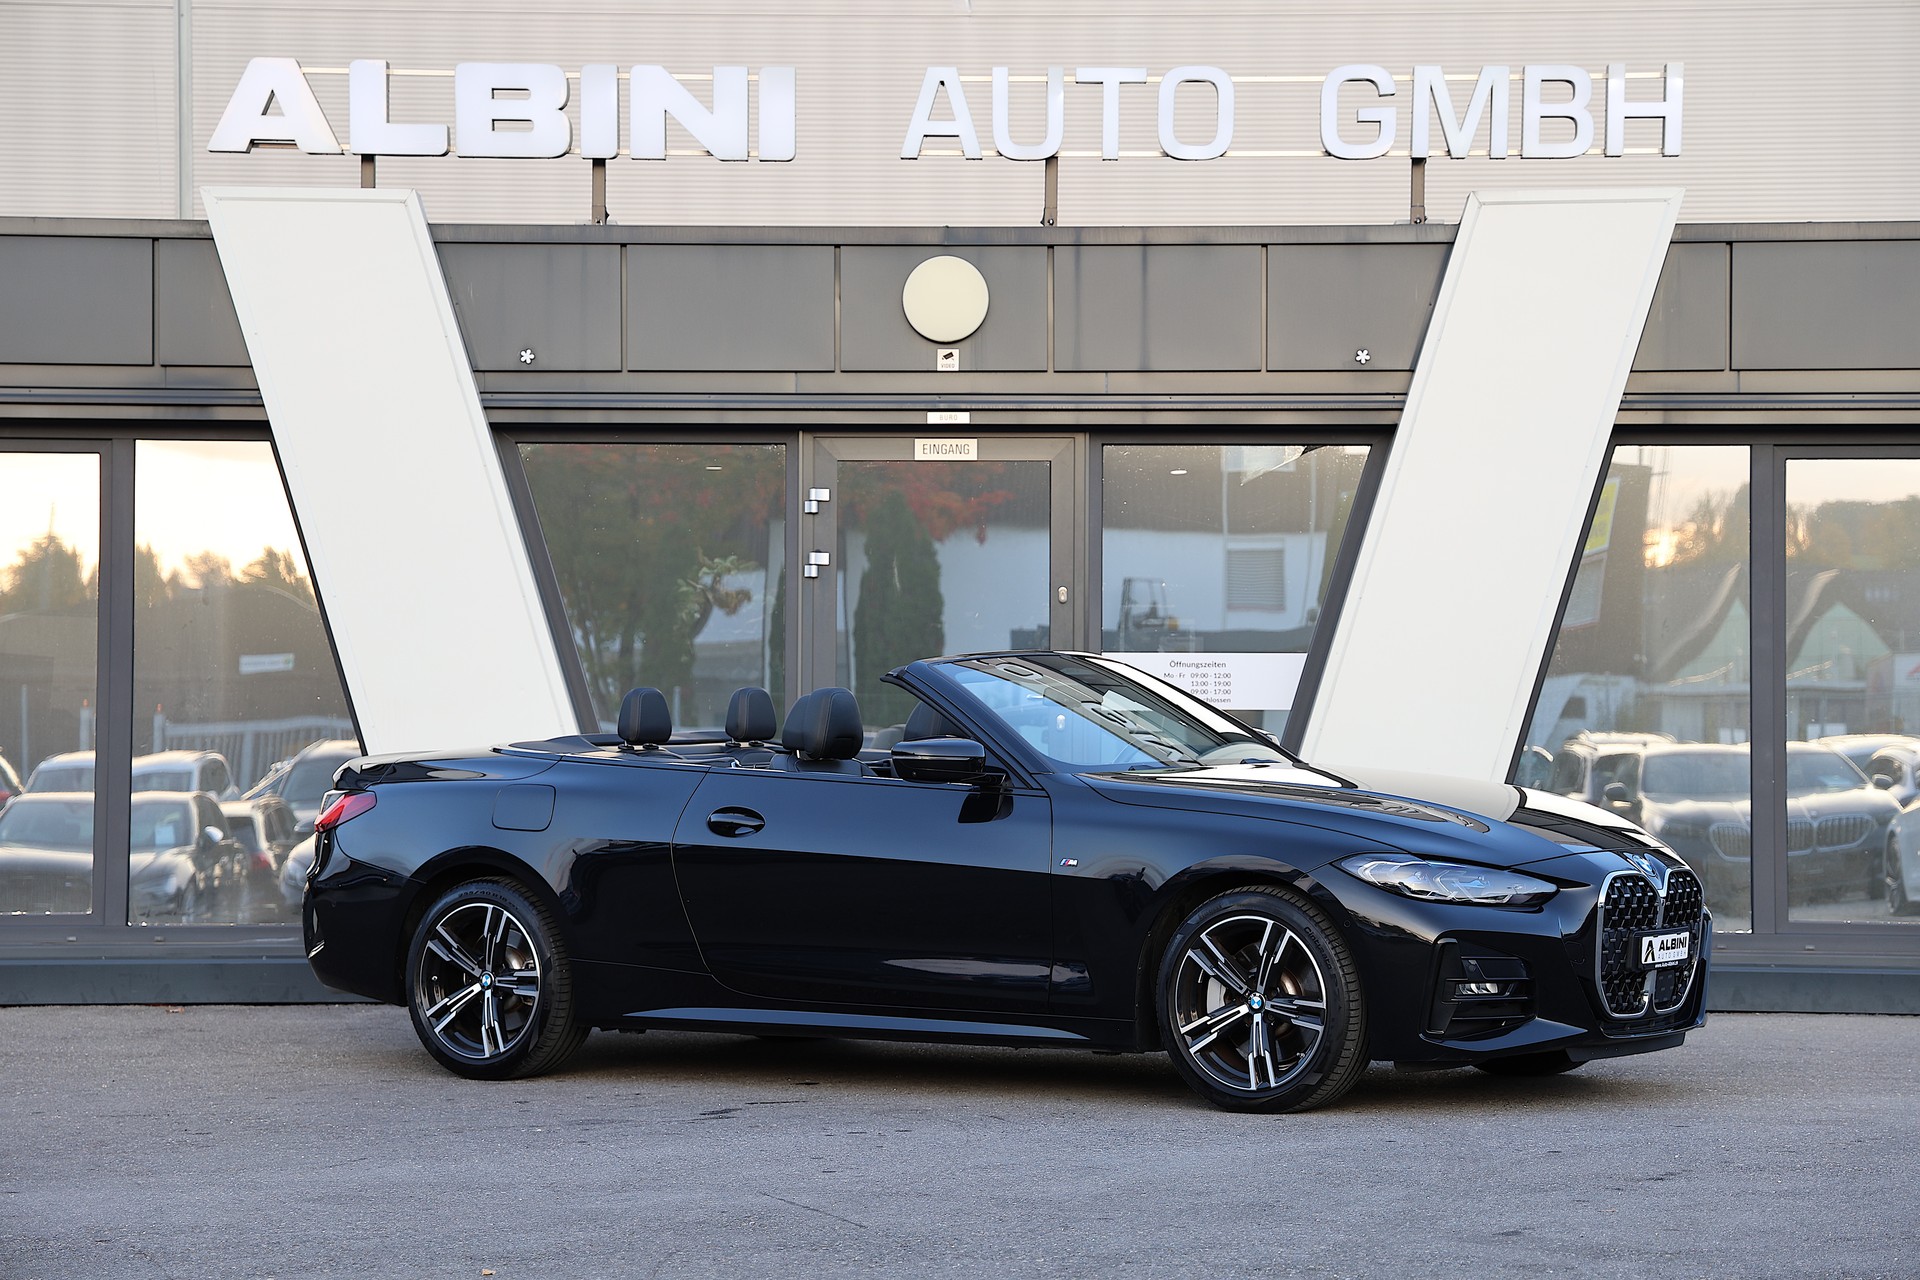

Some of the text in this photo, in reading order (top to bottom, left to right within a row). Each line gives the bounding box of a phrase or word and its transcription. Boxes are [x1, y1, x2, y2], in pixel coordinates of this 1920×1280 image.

[207, 57, 1685, 162] ALBINI AUTO GMBH
[922, 443, 970, 455] EINGANG
[1658, 937, 1687, 951] ALBINI
